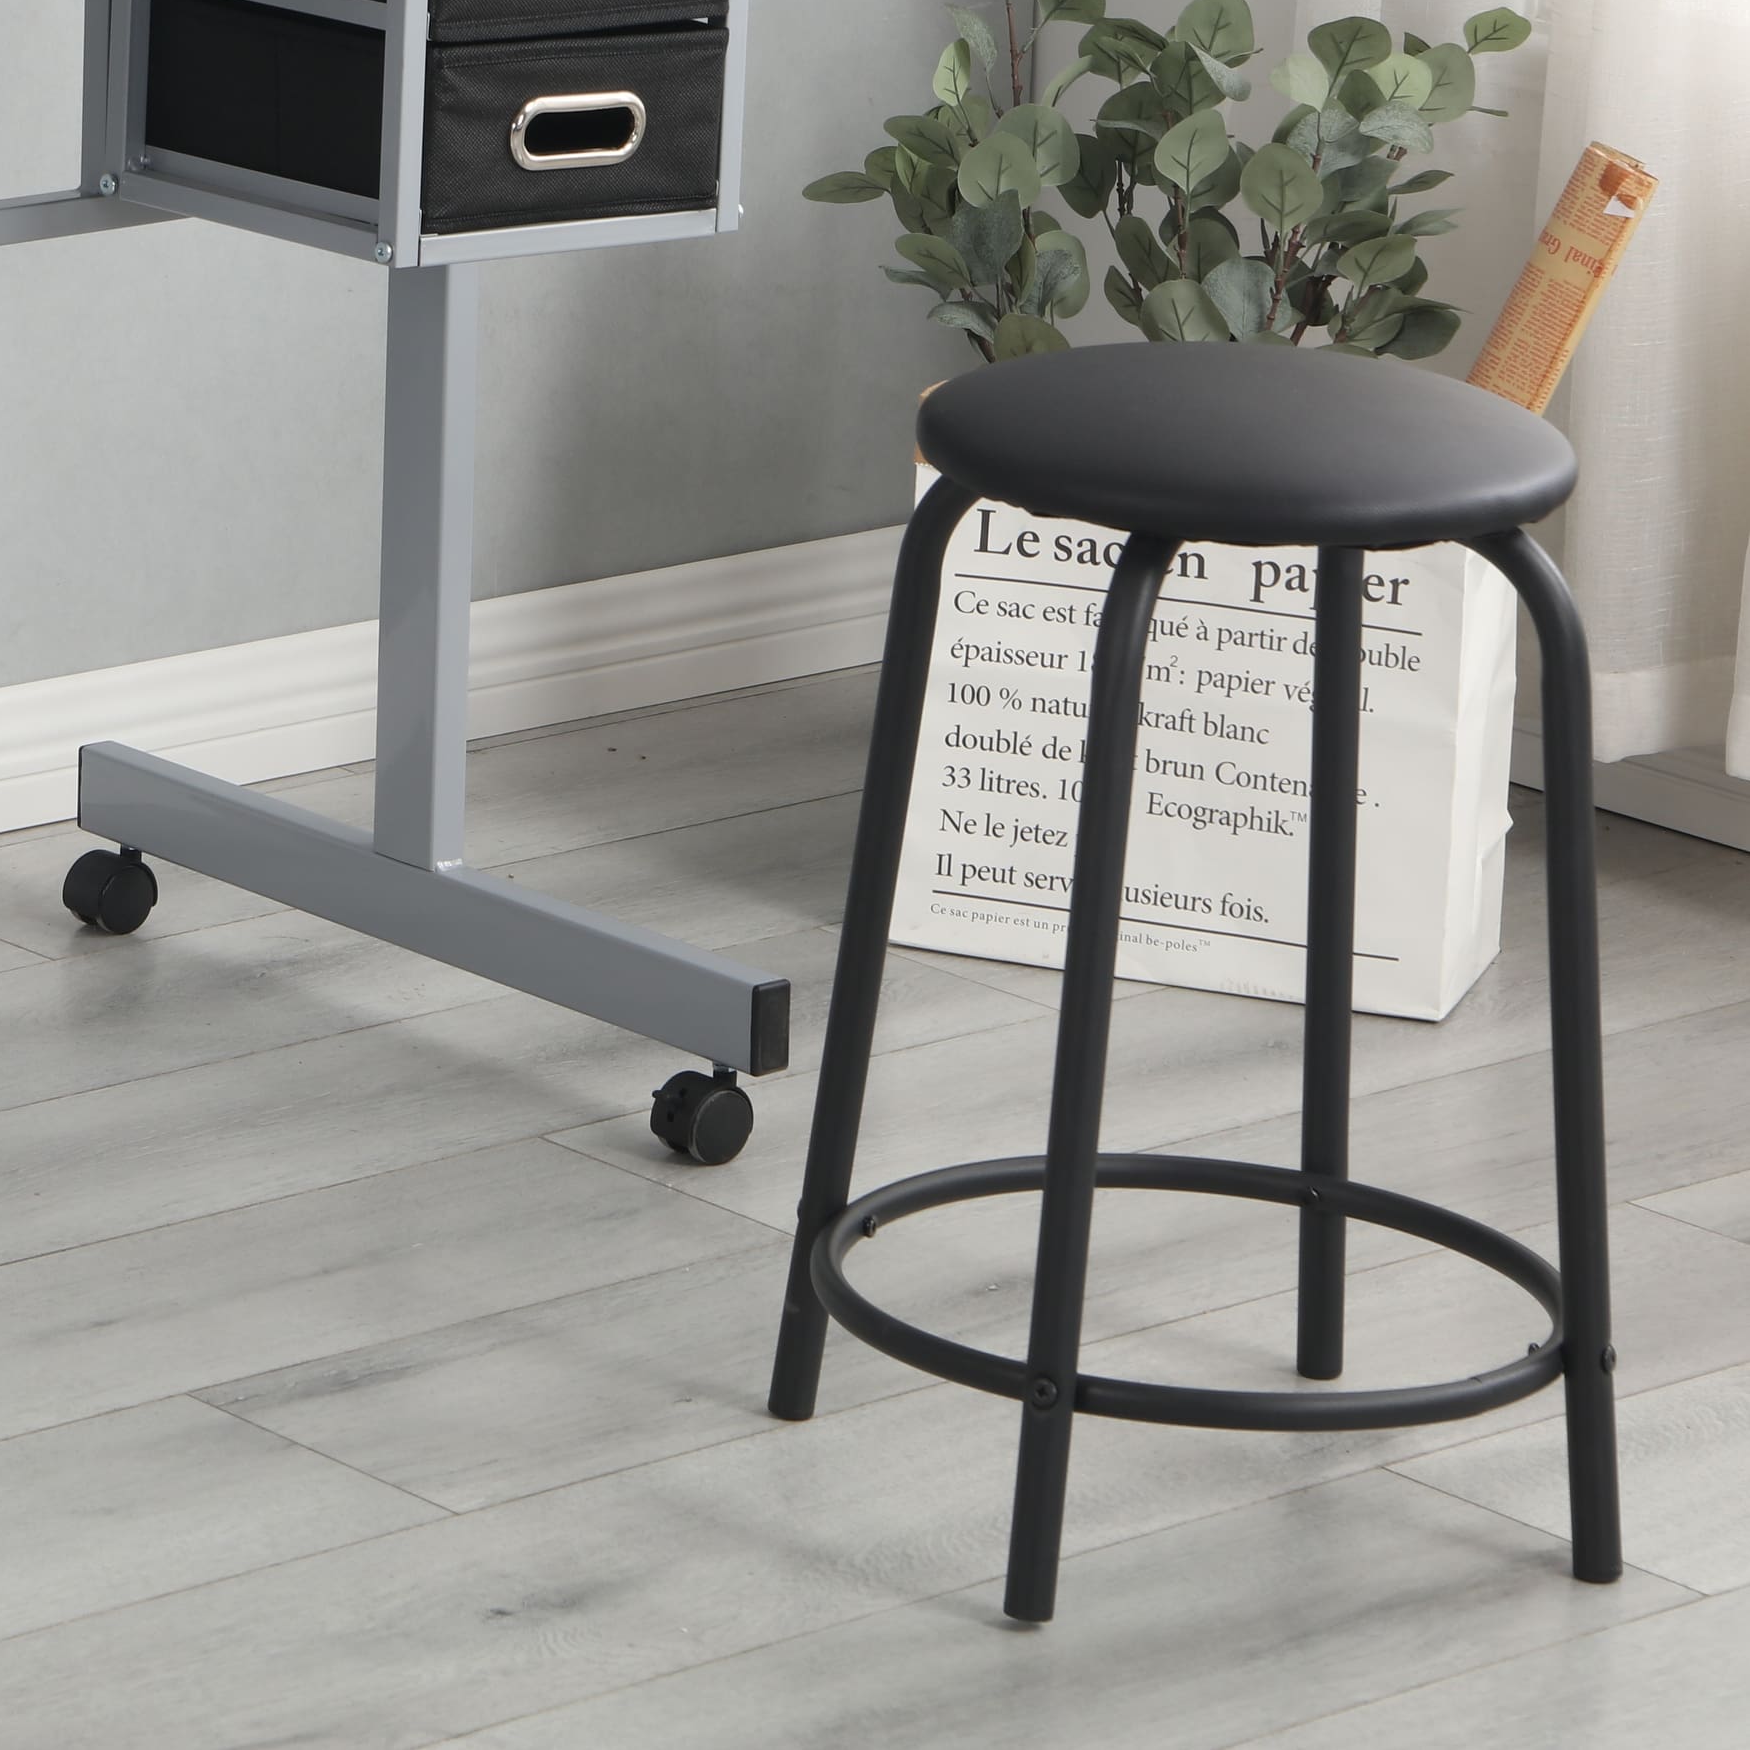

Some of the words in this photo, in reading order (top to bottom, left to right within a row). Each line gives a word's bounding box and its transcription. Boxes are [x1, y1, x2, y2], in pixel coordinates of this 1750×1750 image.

[974, 508, 1040, 558] Le
[1249, 558, 1410, 611] paer
[954, 590, 989, 615] Ce
[996, 599, 1035, 620] sac
[1042, 602, 1075, 625] est
[1196, 619, 1210, 642] à
[1216, 626, 1288, 651] partir
[950, 637, 1069, 670] épaisseur
[1196, 668, 1277, 698] papier
[947, 682, 991, 706] 100
[999, 687, 1022, 710] %
[1030, 696, 1090, 718] natu
[1136, 701, 1196, 734] kraft
[1203, 711, 1270, 745] blanc
[944, 724, 1032, 757] doublé
[1041, 736, 1072, 762] de
[1145, 748, 1205, 781] brun
[942, 765, 971, 789] 33
[978, 767, 1048, 799] litres.
[1058, 779, 1083, 802] 10
[939, 808, 977, 834] Ne
[983, 813, 1005, 838] le
[1010, 818, 1068, 848] jetez
[930, 903, 947, 915] Ce
[949, 907, 969, 918] sac
[971, 910, 1011, 925] papier
[1013, 915, 1030, 928] est
[1033, 920, 1049, 930] un
[935, 852, 953, 877] Il
[960, 861, 1017, 886] peut
[1023, 870, 1075, 893] serv
[1124, 883, 1213, 914] usieurs
[1219, 892, 1270, 924] fois.
